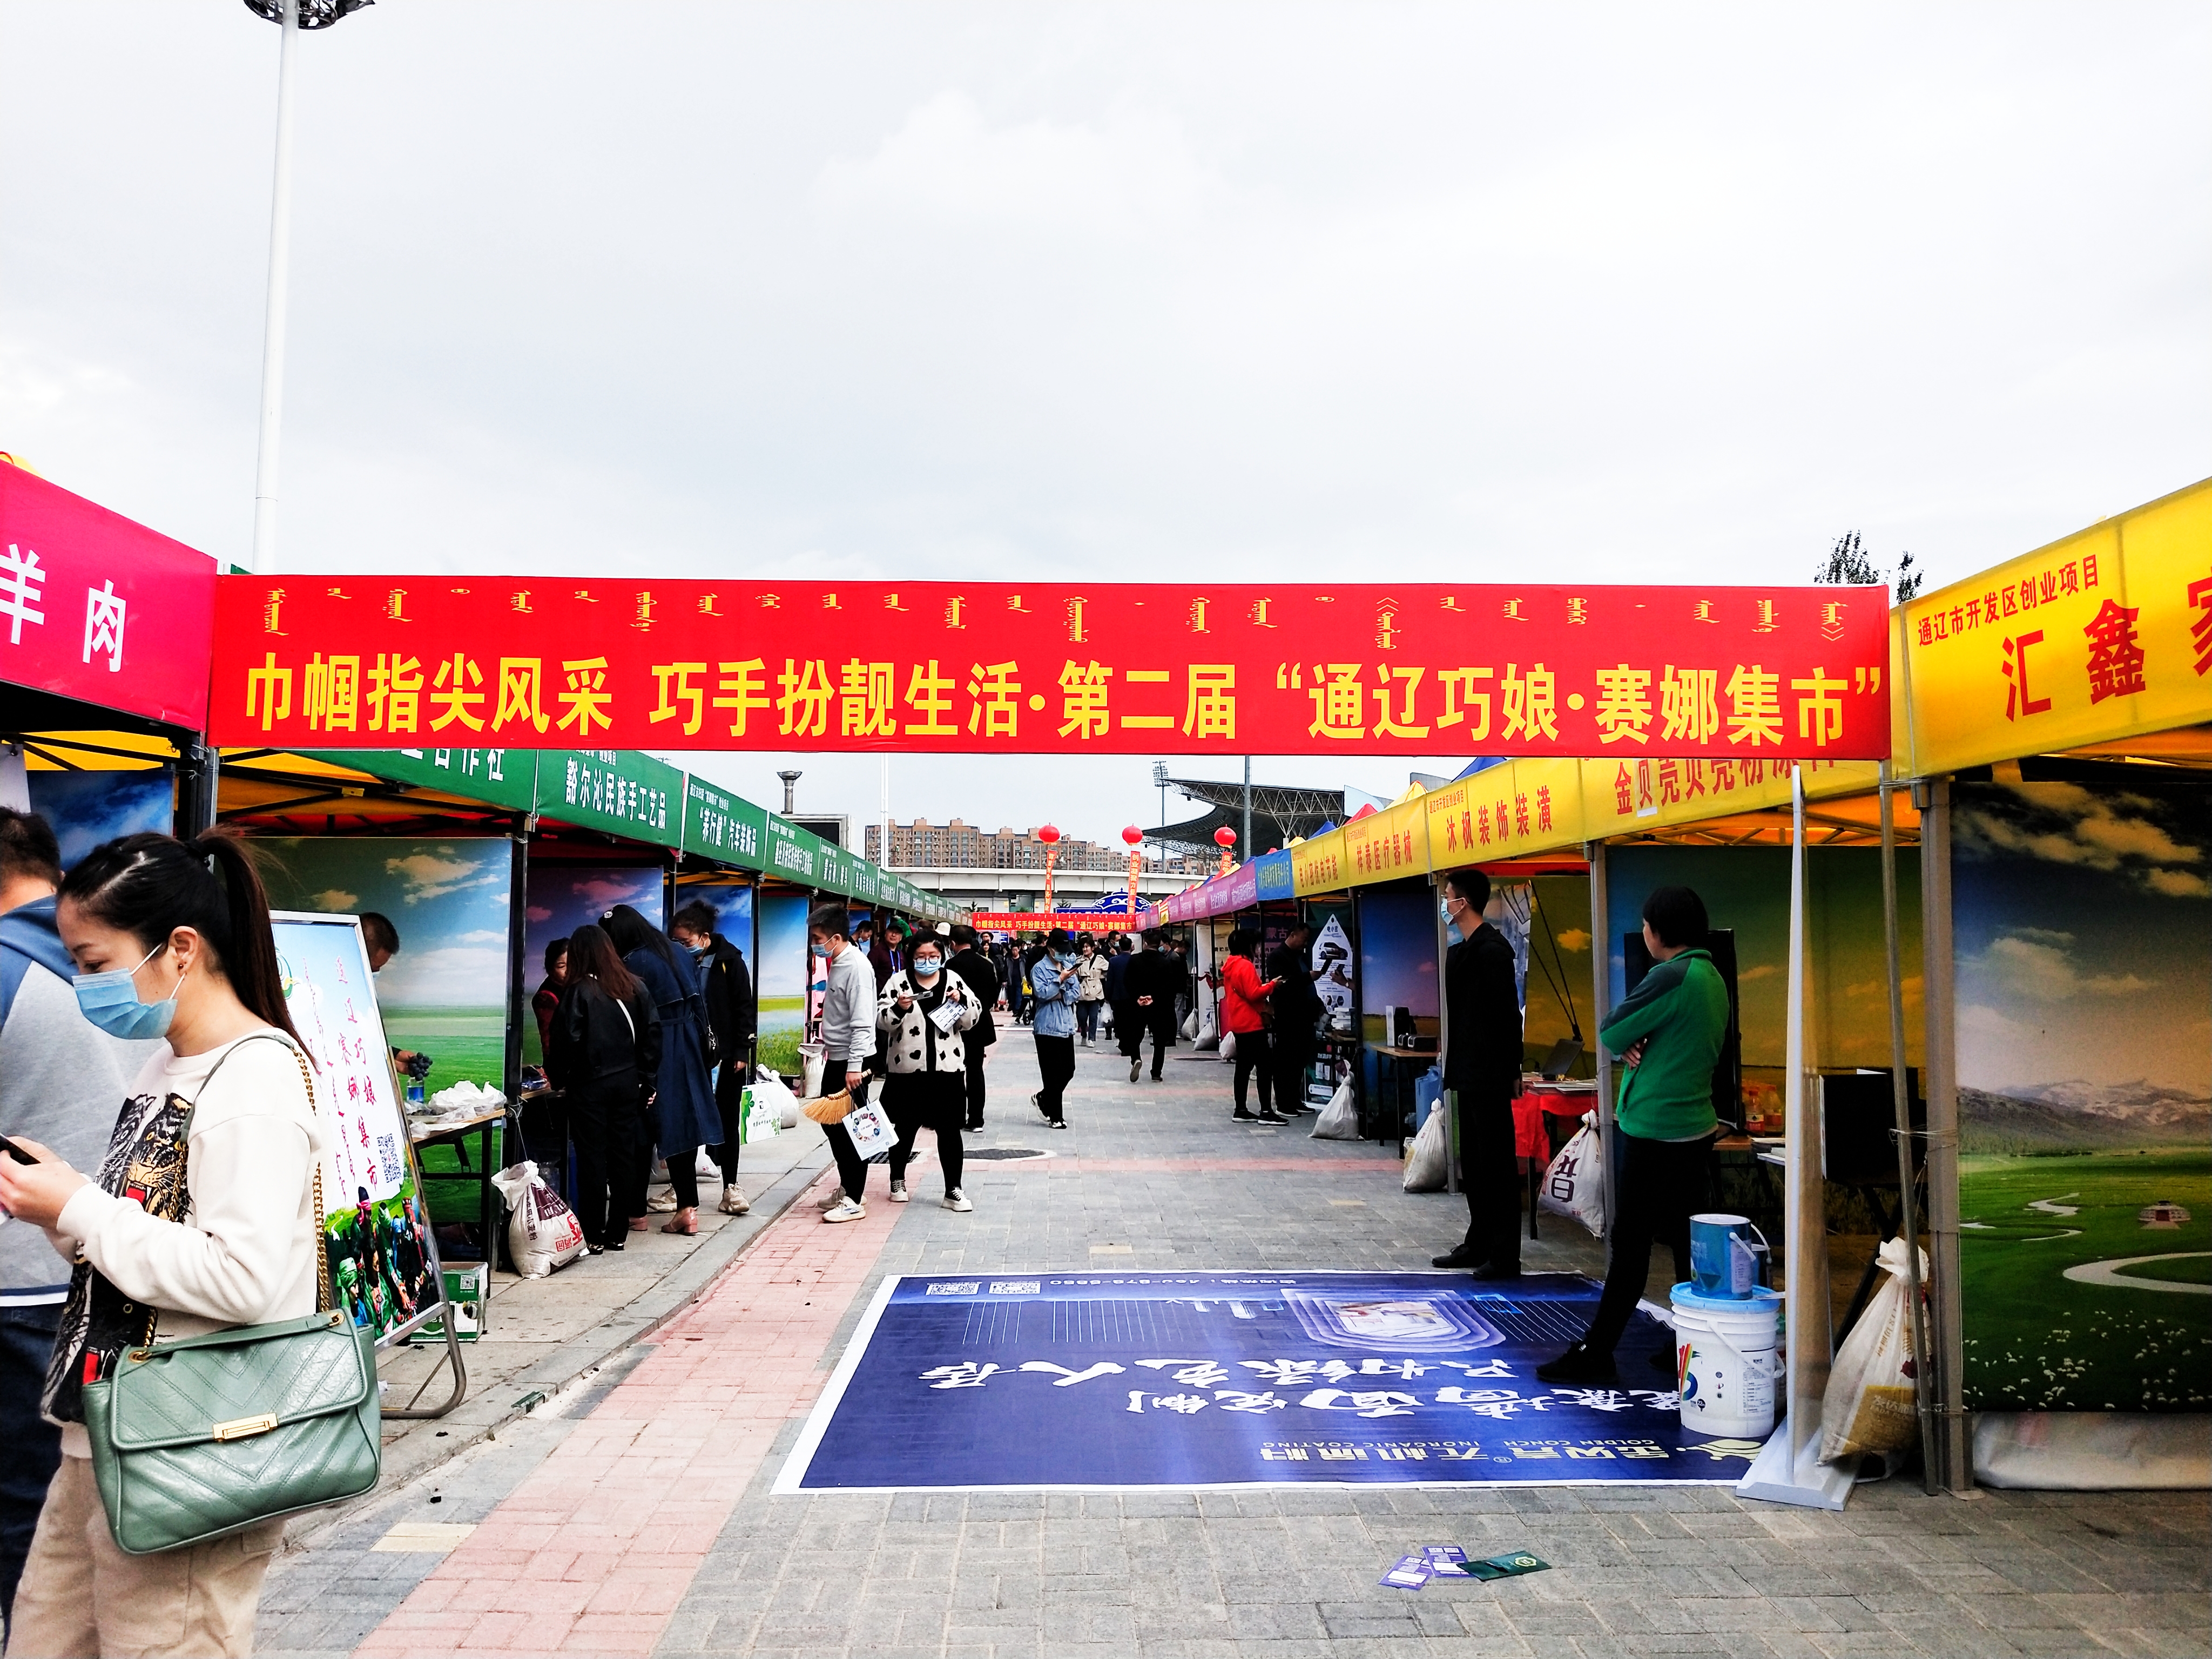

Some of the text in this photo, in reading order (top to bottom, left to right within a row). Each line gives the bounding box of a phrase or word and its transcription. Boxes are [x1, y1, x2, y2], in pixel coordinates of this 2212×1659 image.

[0, 543, 126, 672] 羊肉
[1918, 554, 2099, 647] 通辽市开发区创业项目
[246, 652, 1881, 747] 巾帼指尖风采 巧手扮靓生活·第二届 “通辽巧娘·赛娜集市”
[1429, 789, 1465, 814] 通辽市开发区创业项目
[1614, 758, 1835, 815] 金贝壳贝壳粉
[1446, 784, 1553, 853] 沐枫装饰装潢
[975, 920, 1013, 929] 巾帼指尖风采
[918, 1358, 1519, 1389] 只为绿色人居
